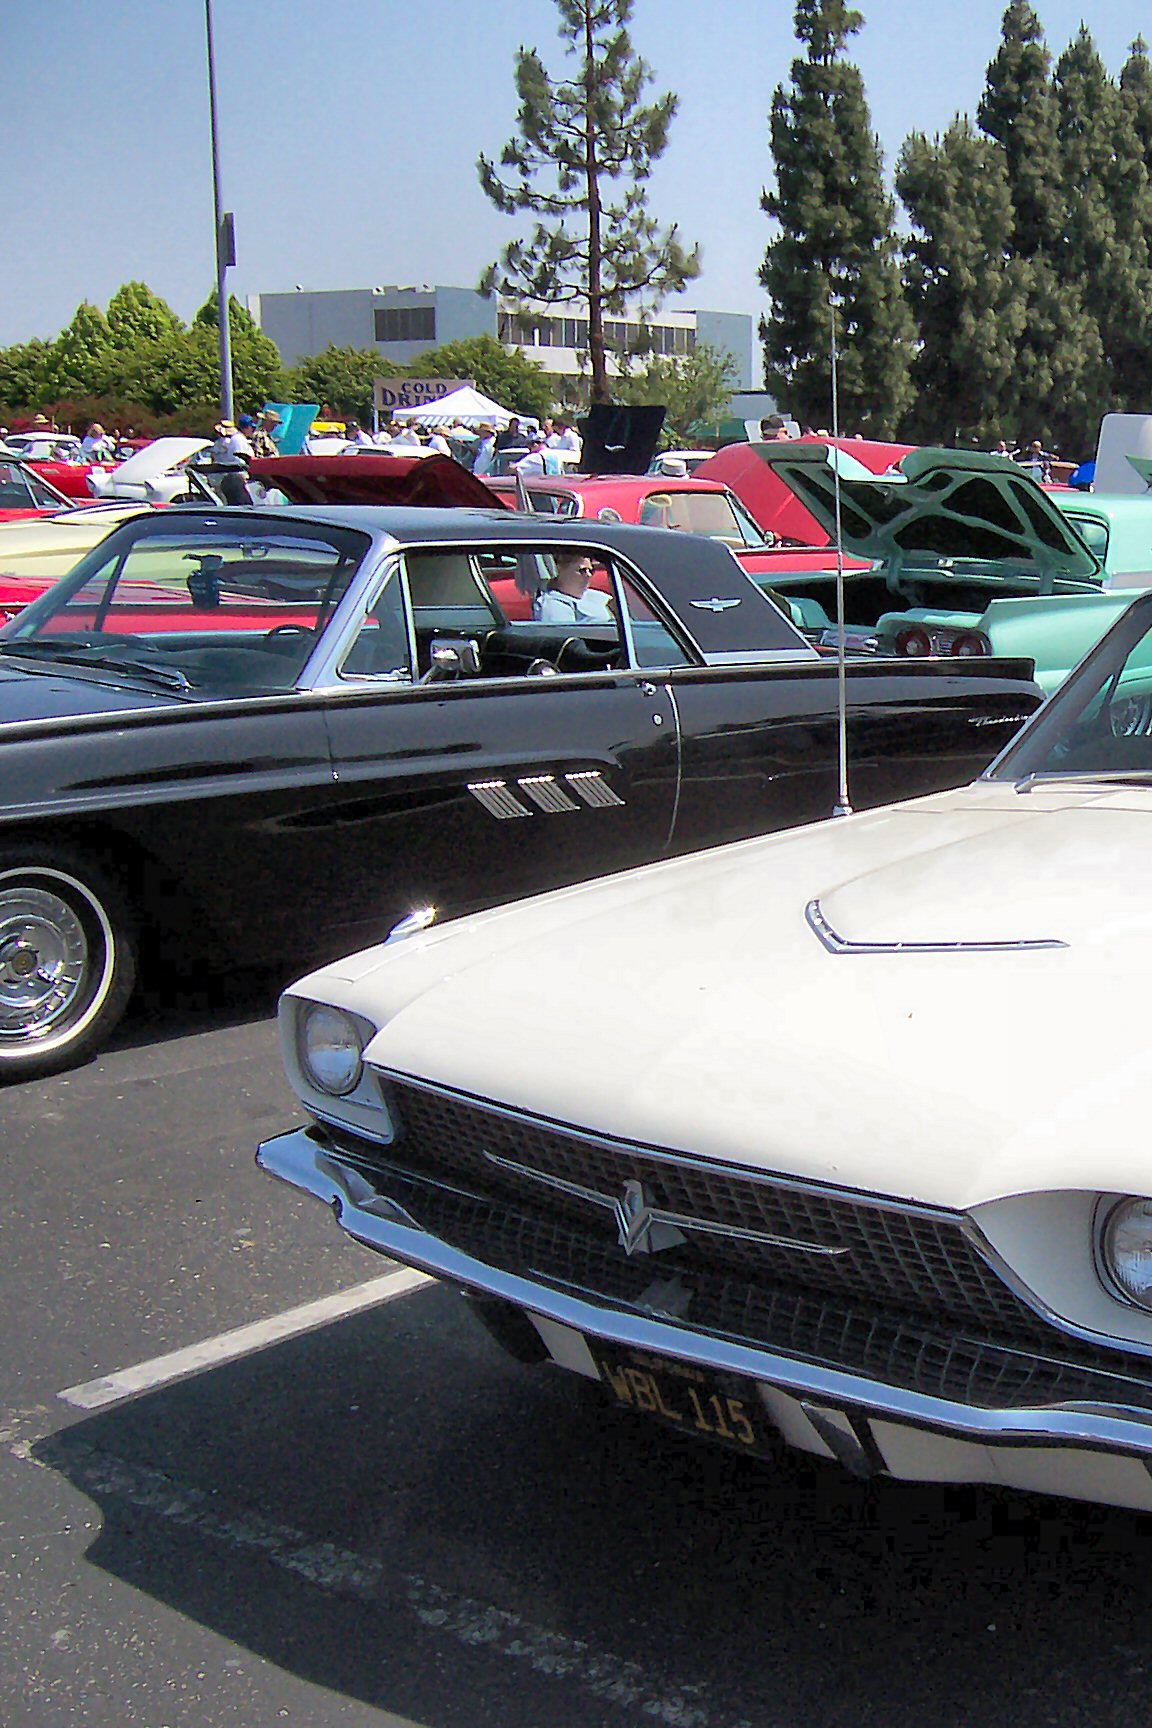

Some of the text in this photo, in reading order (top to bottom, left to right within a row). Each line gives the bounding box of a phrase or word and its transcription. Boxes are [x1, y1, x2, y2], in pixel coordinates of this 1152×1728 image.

[382, 386, 444, 407] DRIN
[400, 382, 448, 394] COLD
[601, 1360, 683, 1421] WBL
[687, 1386, 756, 1445] 115
